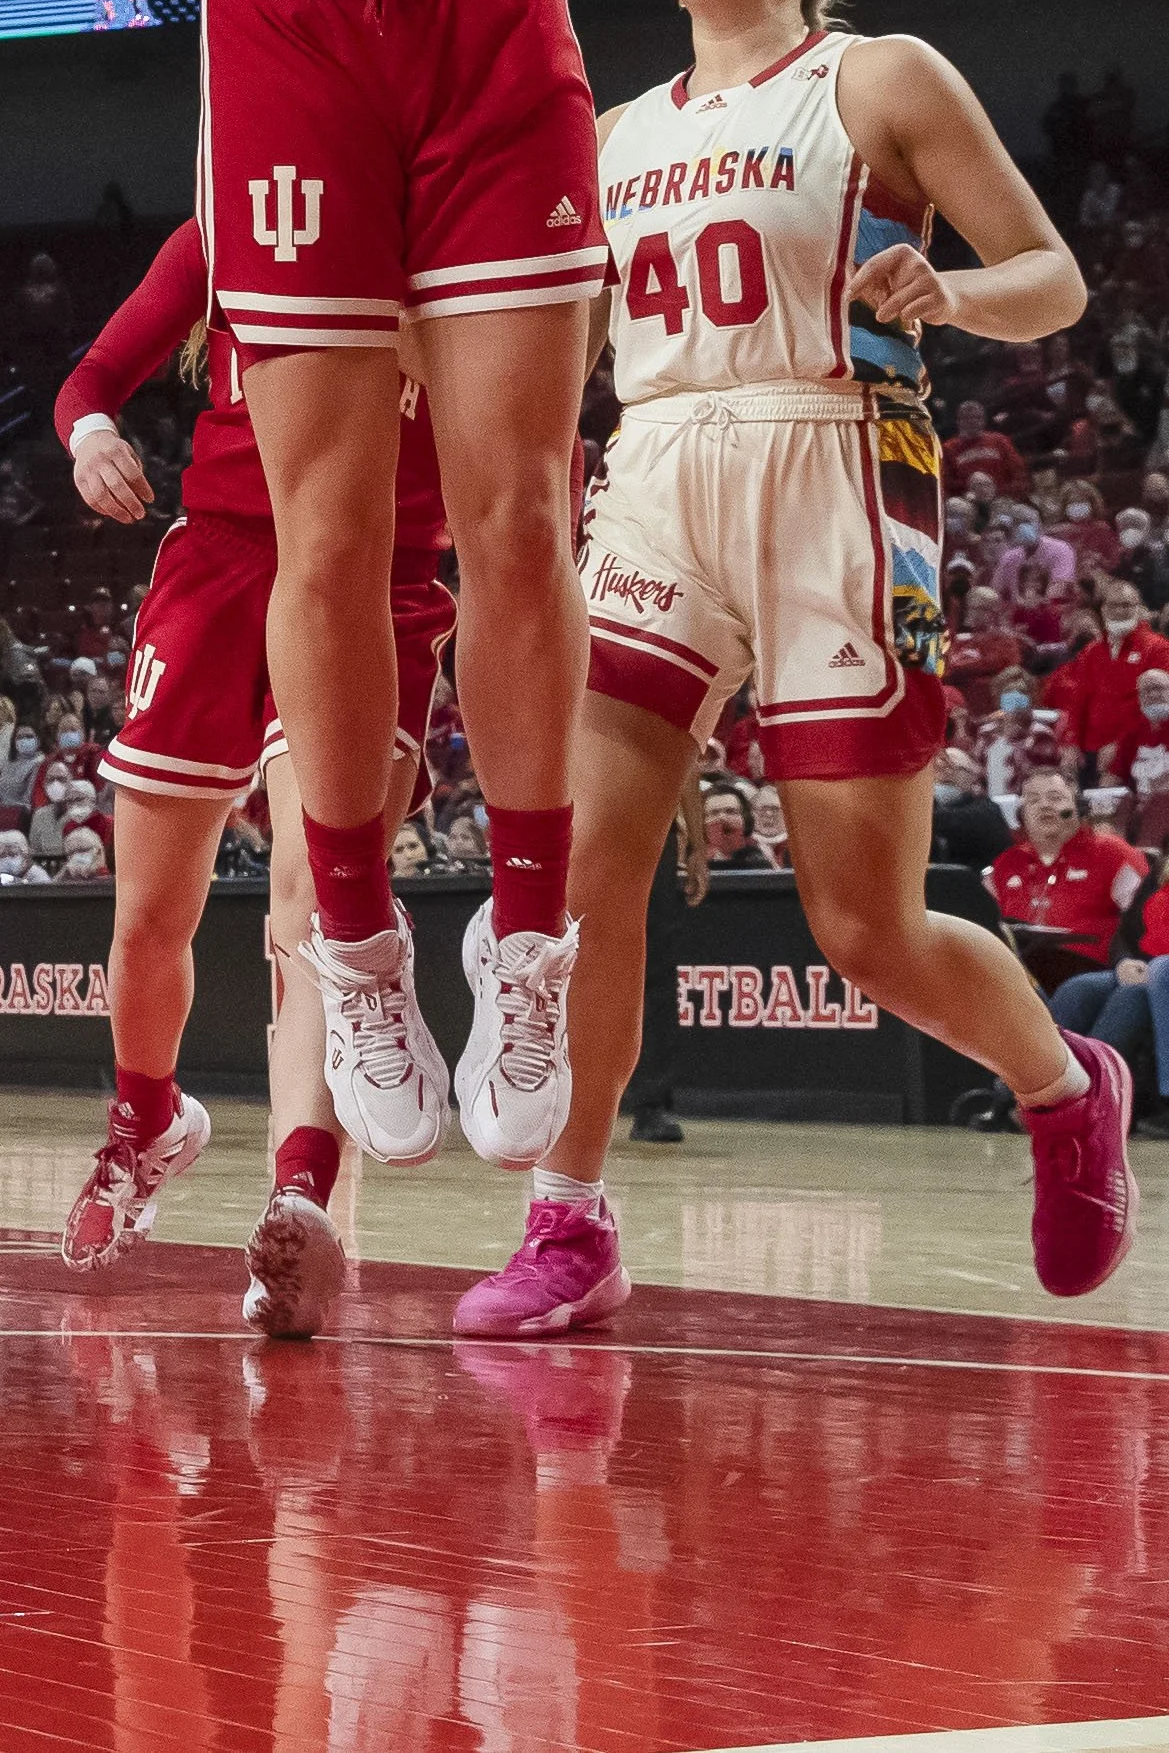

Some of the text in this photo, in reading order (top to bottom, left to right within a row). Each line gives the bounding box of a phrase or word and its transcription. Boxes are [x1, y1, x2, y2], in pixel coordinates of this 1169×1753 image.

[606, 145, 796, 226] NEBRASKA
[546, 213, 582, 228] adidas
[626, 219, 769, 338] 40
[590, 552, 684, 614] Huskers
[828, 658, 866, 668] adidas
